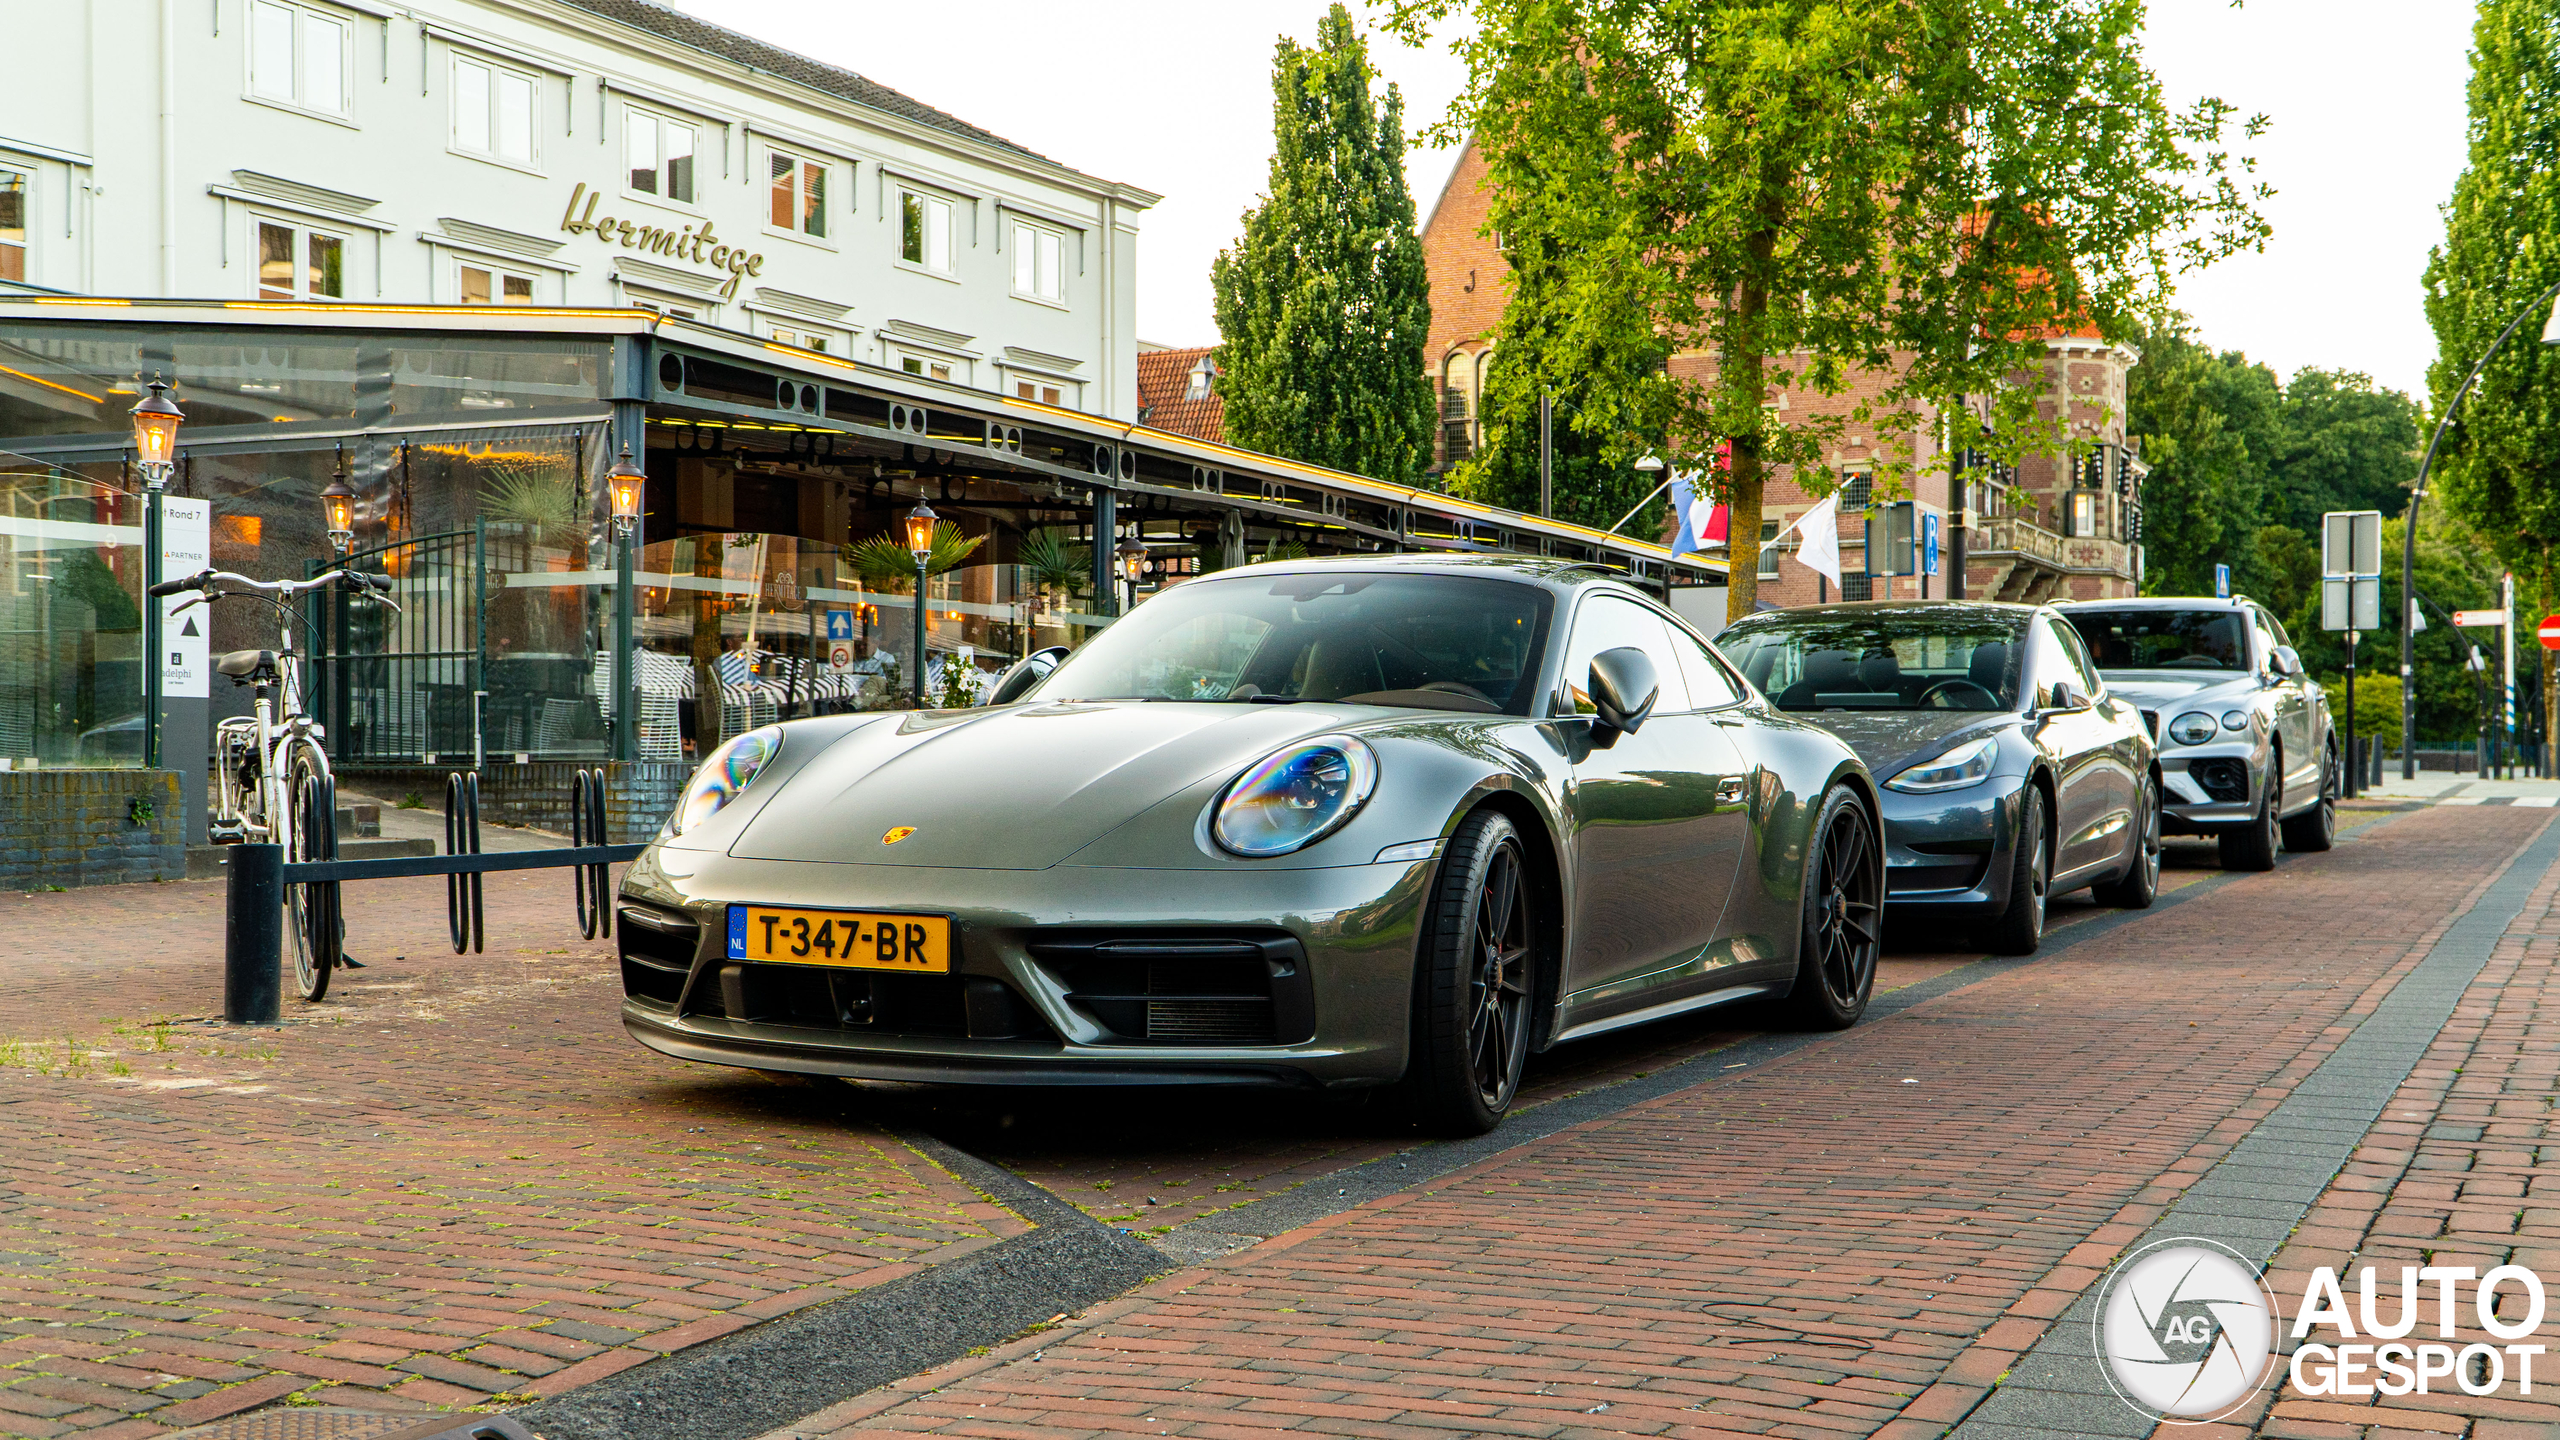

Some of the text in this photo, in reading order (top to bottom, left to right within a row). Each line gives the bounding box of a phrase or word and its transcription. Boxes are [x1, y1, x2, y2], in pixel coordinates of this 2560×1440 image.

[561, 182, 764, 304] Hermitage
[170, 508, 193, 520] Rond
[195, 511, 201, 520] 7
[1929, 517, 1937, 548] P
[171, 551, 203, 561] PARTNER
[161, 668, 192, 680] adelphi
[731, 915, 928, 964] NL T-347-BR
